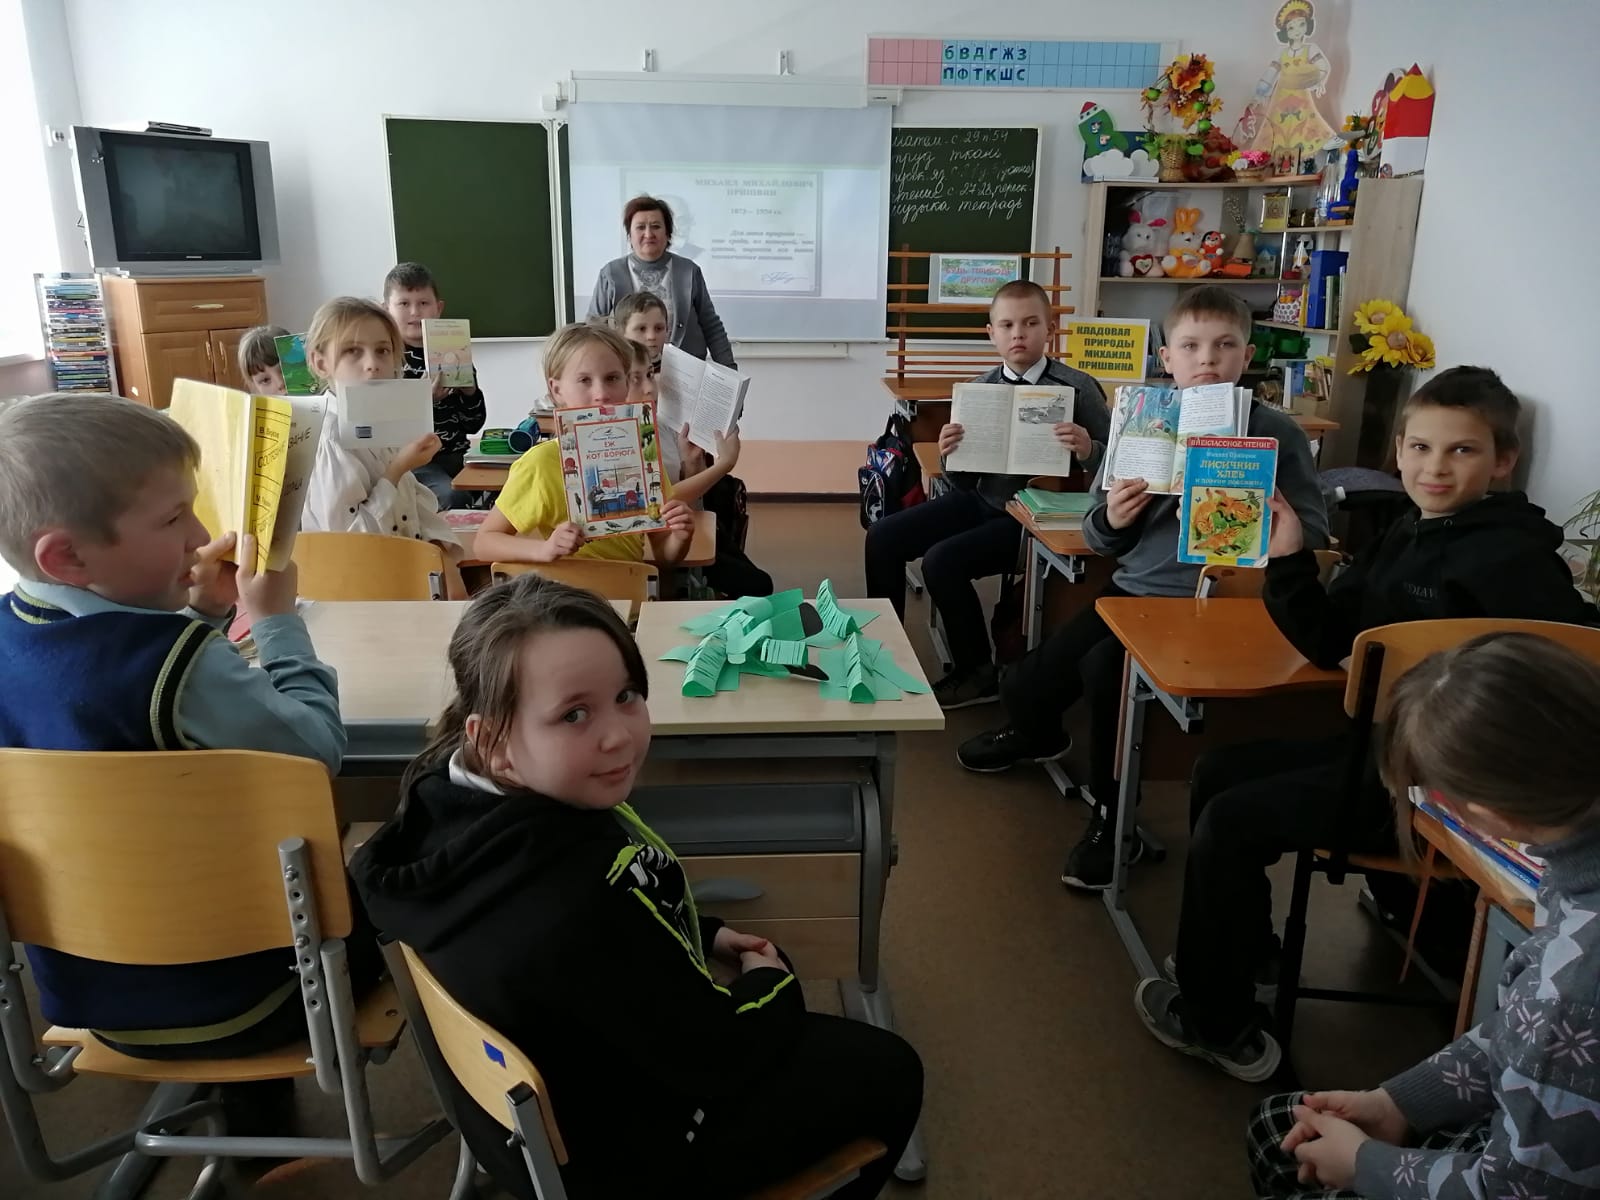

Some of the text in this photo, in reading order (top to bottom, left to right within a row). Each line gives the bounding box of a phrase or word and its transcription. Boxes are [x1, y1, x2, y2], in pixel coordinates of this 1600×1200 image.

[1076, 326, 1131, 336] КЛАДОВАЯ
[1084, 338, 1135, 349] ПРИРОДЫ
[1084, 350, 1132, 360] МИХАИЛА
[1078, 360, 1134, 371] ПРИШВИНА
[1190, 439, 1273, 449] ВНЕКЛАССНОЕ ЧТЕНИЕ
[1200, 459, 1261, 471] ЛИСИЧКИН
[1216, 470, 1245, 479] ХЛЕБ
